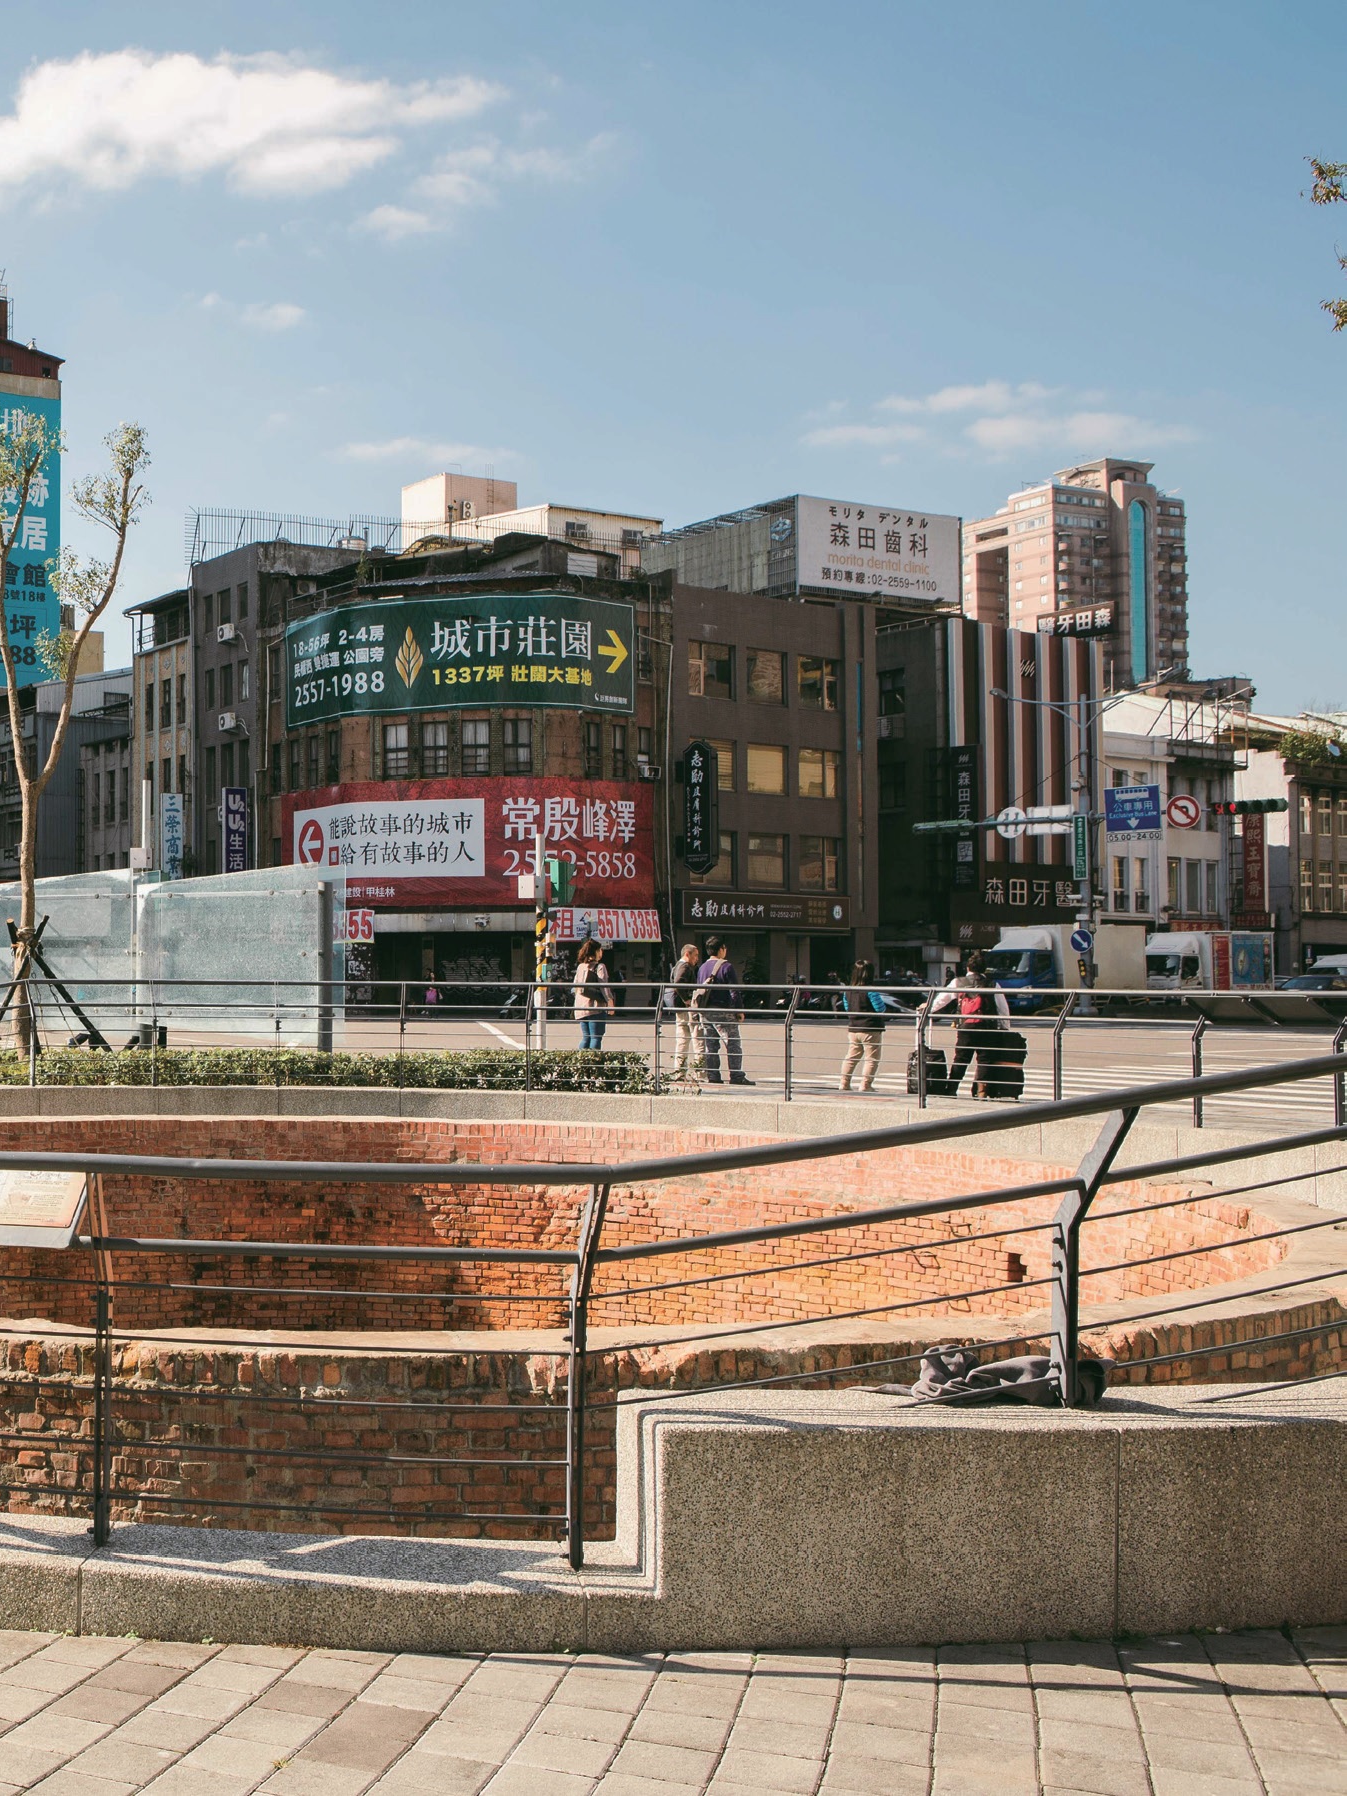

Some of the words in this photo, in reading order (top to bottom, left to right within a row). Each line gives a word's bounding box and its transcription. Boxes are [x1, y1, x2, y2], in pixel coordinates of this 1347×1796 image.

[829, 506, 865, 520] モリタ
[878, 513, 929, 529] デンタル
[830, 522, 928, 558] 森田齒科
[827, 552, 864, 567] morita
[867, 556, 901, 572] dental
[904, 560, 929, 575] clinic
[293, 633, 330, 657] 18-56坪
[338, 625, 384, 645] 2-4房
[430, 616, 592, 660] 城市莊園
[343, 647, 384, 665] 公園旁
[295, 671, 385, 707] 2557-1988
[432, 665, 504, 685] 1337坪
[511, 664, 592, 686] 壯闊大基地
[1113, 800, 1153, 812] 公車專用
[164, 795, 182, 880] 三榮商業
[328, 811, 474, 840] 能說故事的城市
[365, 887, 395, 898] 甲桂林
[984, 877, 1073, 906] 森田牙醫
[597, 909, 660, 940] 5571-3355
